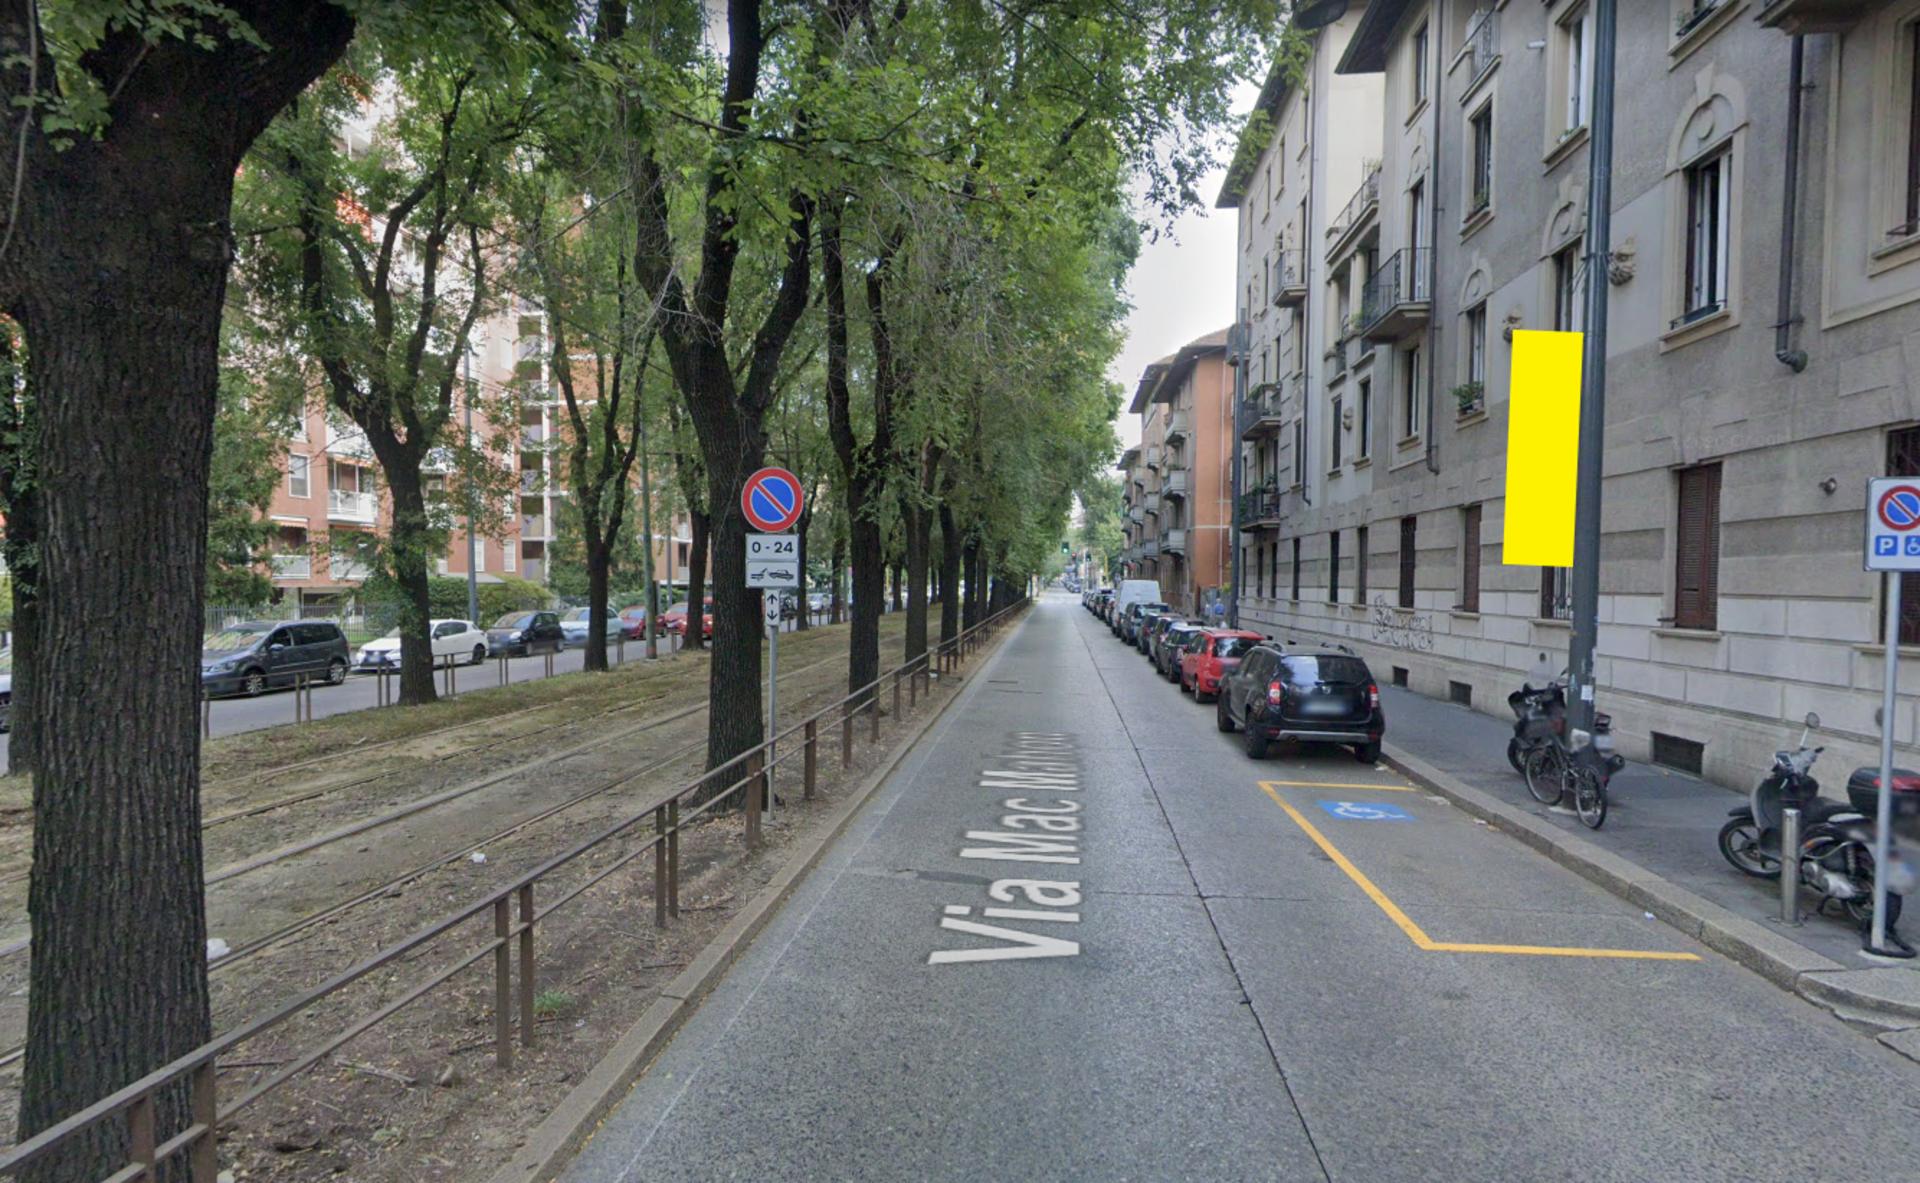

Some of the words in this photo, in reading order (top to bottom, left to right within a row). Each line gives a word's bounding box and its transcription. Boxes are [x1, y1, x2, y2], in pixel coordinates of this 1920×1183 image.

[752, 541, 761, 553] 0
[774, 541, 793, 553] 24
[1880, 538, 1895, 554] P
